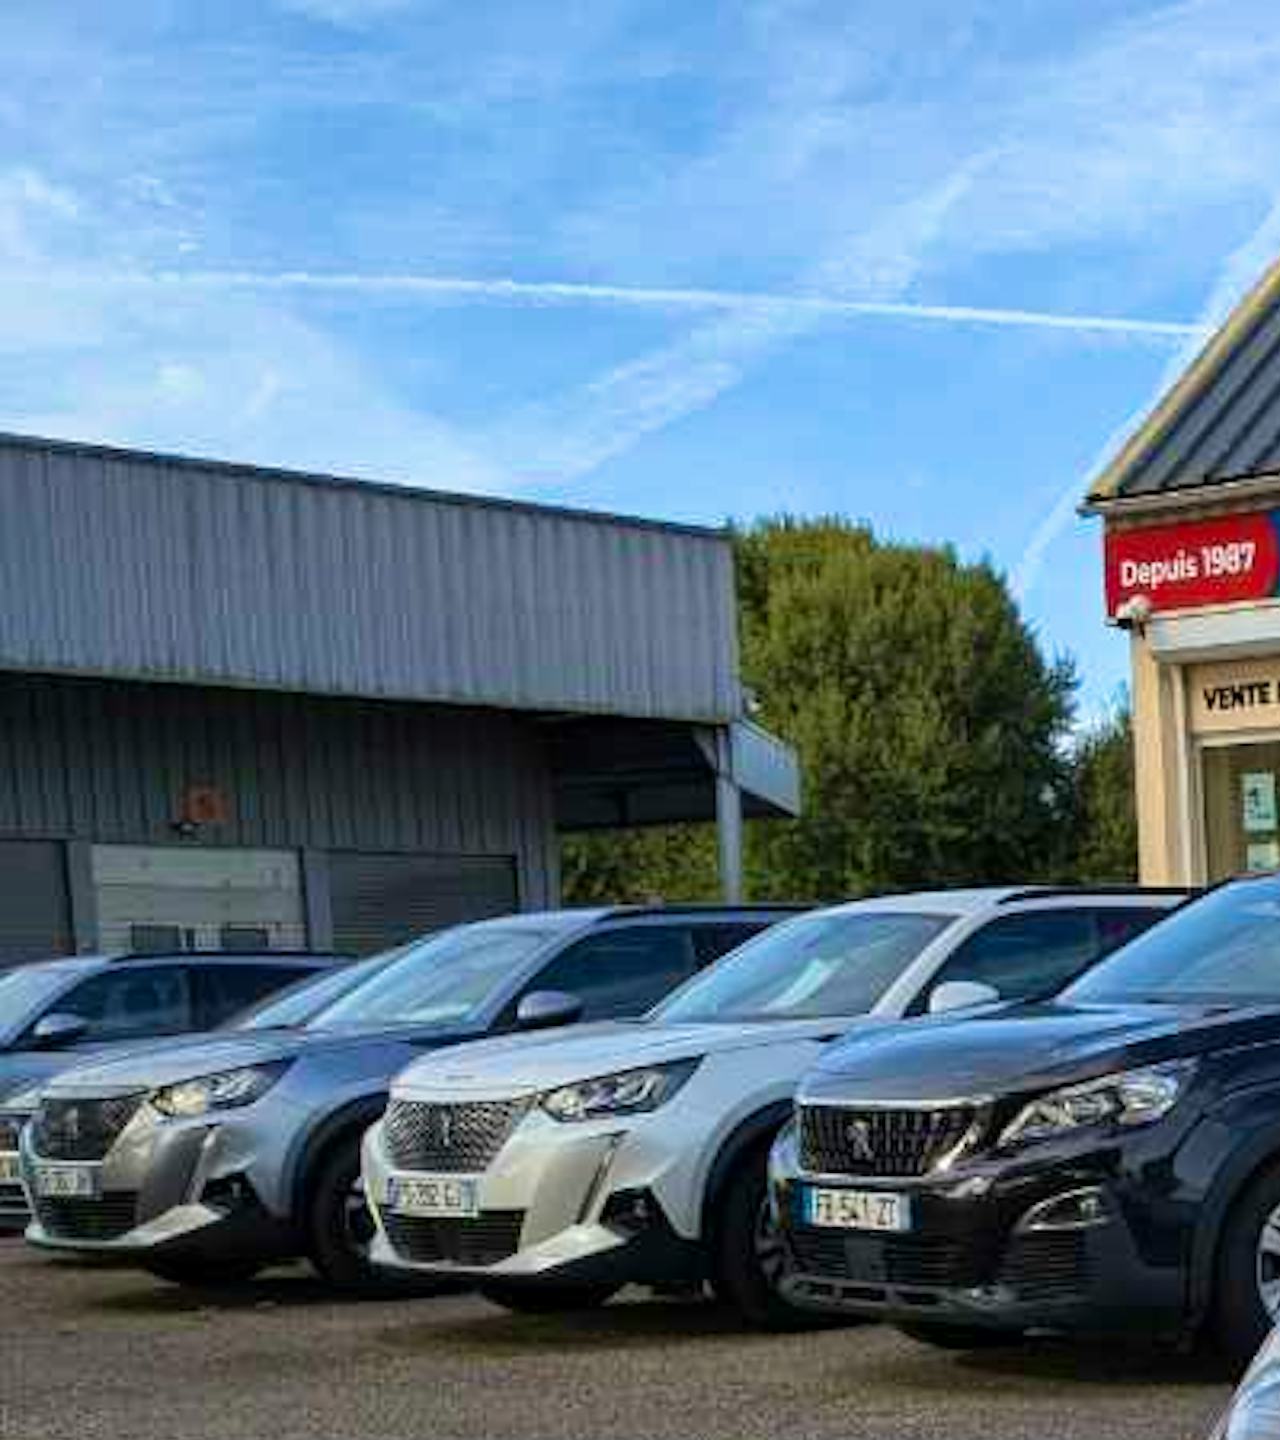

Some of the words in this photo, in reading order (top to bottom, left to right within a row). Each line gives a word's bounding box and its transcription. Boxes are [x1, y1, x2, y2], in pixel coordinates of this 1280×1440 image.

[1120, 547, 1199, 591] Depuis
[1201, 541, 1257, 578] 1987
[1203, 681, 1271, 710] VENTE
